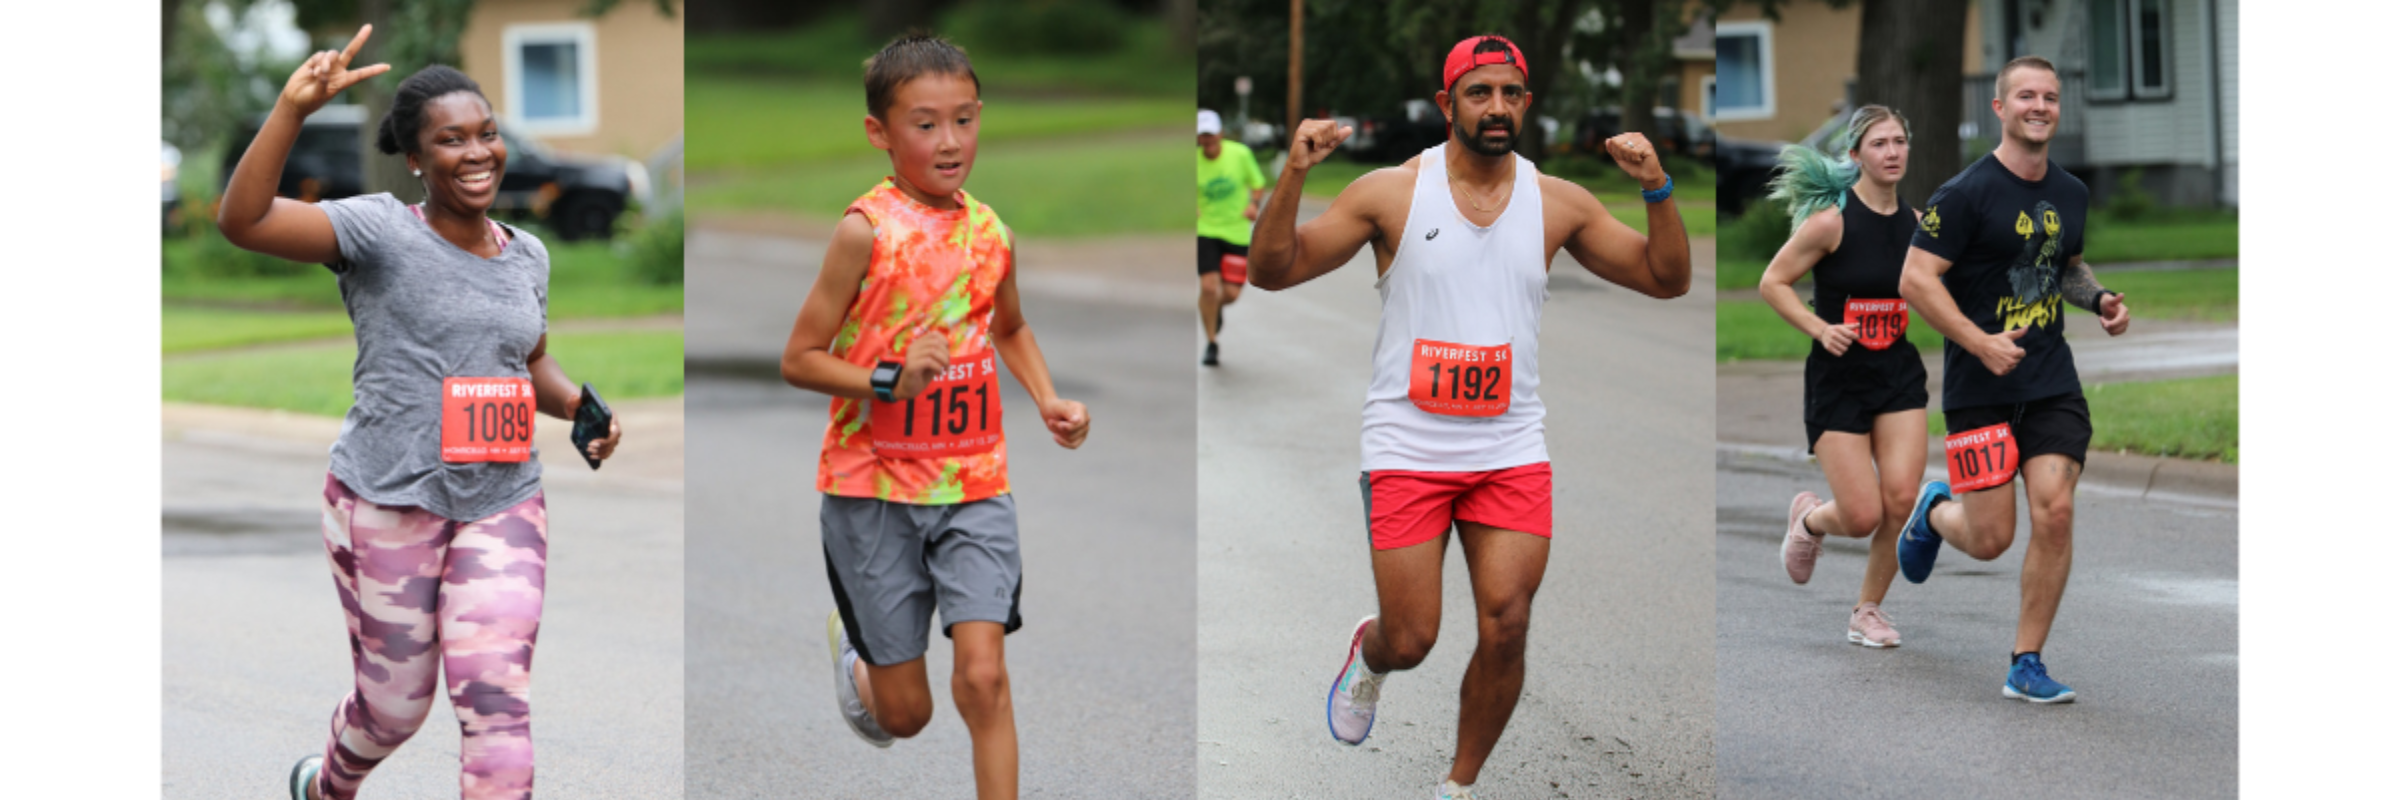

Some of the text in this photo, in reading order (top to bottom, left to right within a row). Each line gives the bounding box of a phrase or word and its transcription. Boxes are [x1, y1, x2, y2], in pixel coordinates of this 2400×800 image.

[1855, 312, 1902, 339] 1019
[1421, 344, 1487, 362] RIVERFEST
[452, 383, 517, 398] RIVERFEST
[1428, 362, 1501, 401] 1192
[463, 401, 529, 442] 1089
[904, 381, 988, 436] 1151
[1953, 441, 2005, 479] 1017
